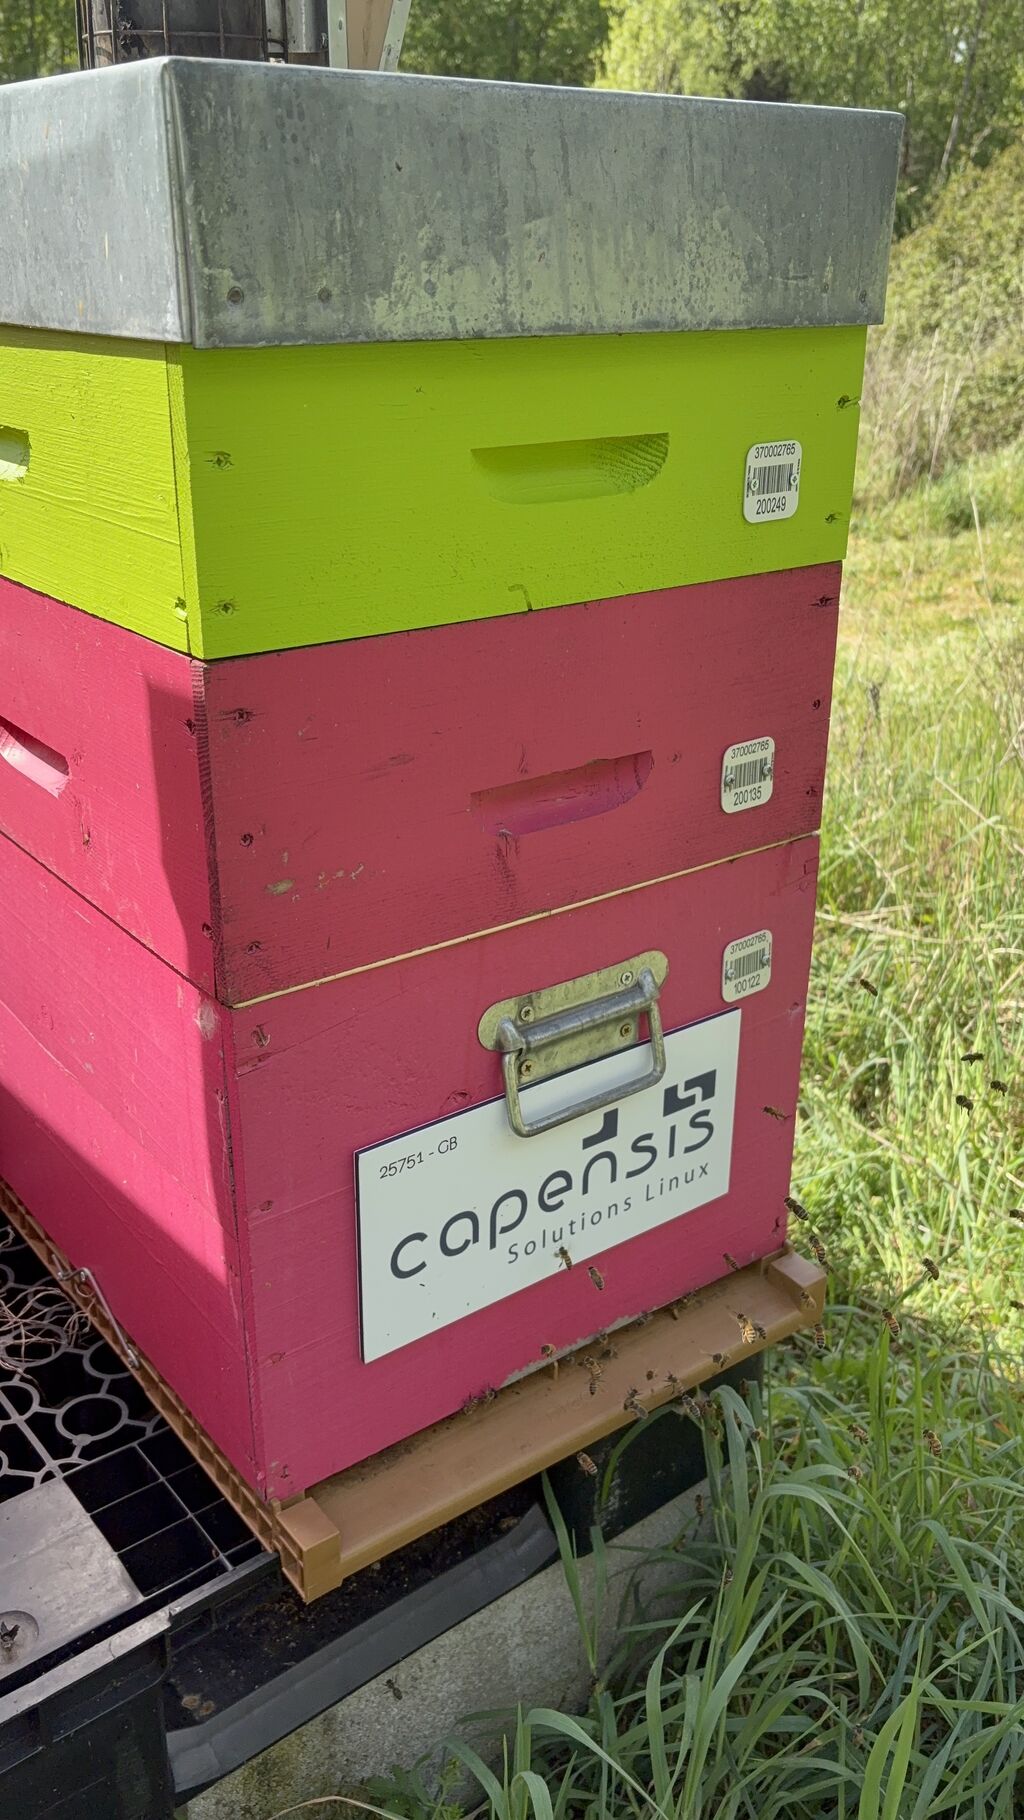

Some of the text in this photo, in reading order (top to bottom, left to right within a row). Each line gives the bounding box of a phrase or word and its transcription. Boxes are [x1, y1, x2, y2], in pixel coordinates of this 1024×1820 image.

[755, 443, 796, 459] 370002765
[756, 496, 787, 515] 200249
[731, 740, 769, 759] 370002765
[733, 786, 762, 806] 200135
[730, 932, 767, 954] 370002765
[734, 974, 761, 994] 100122
[380, 1151, 424, 1179] 25751
[437, 1136, 458, 1154] GB
[390, 1109, 715, 1280] capensis
[507, 1162, 709, 1264] Solutions Linux
